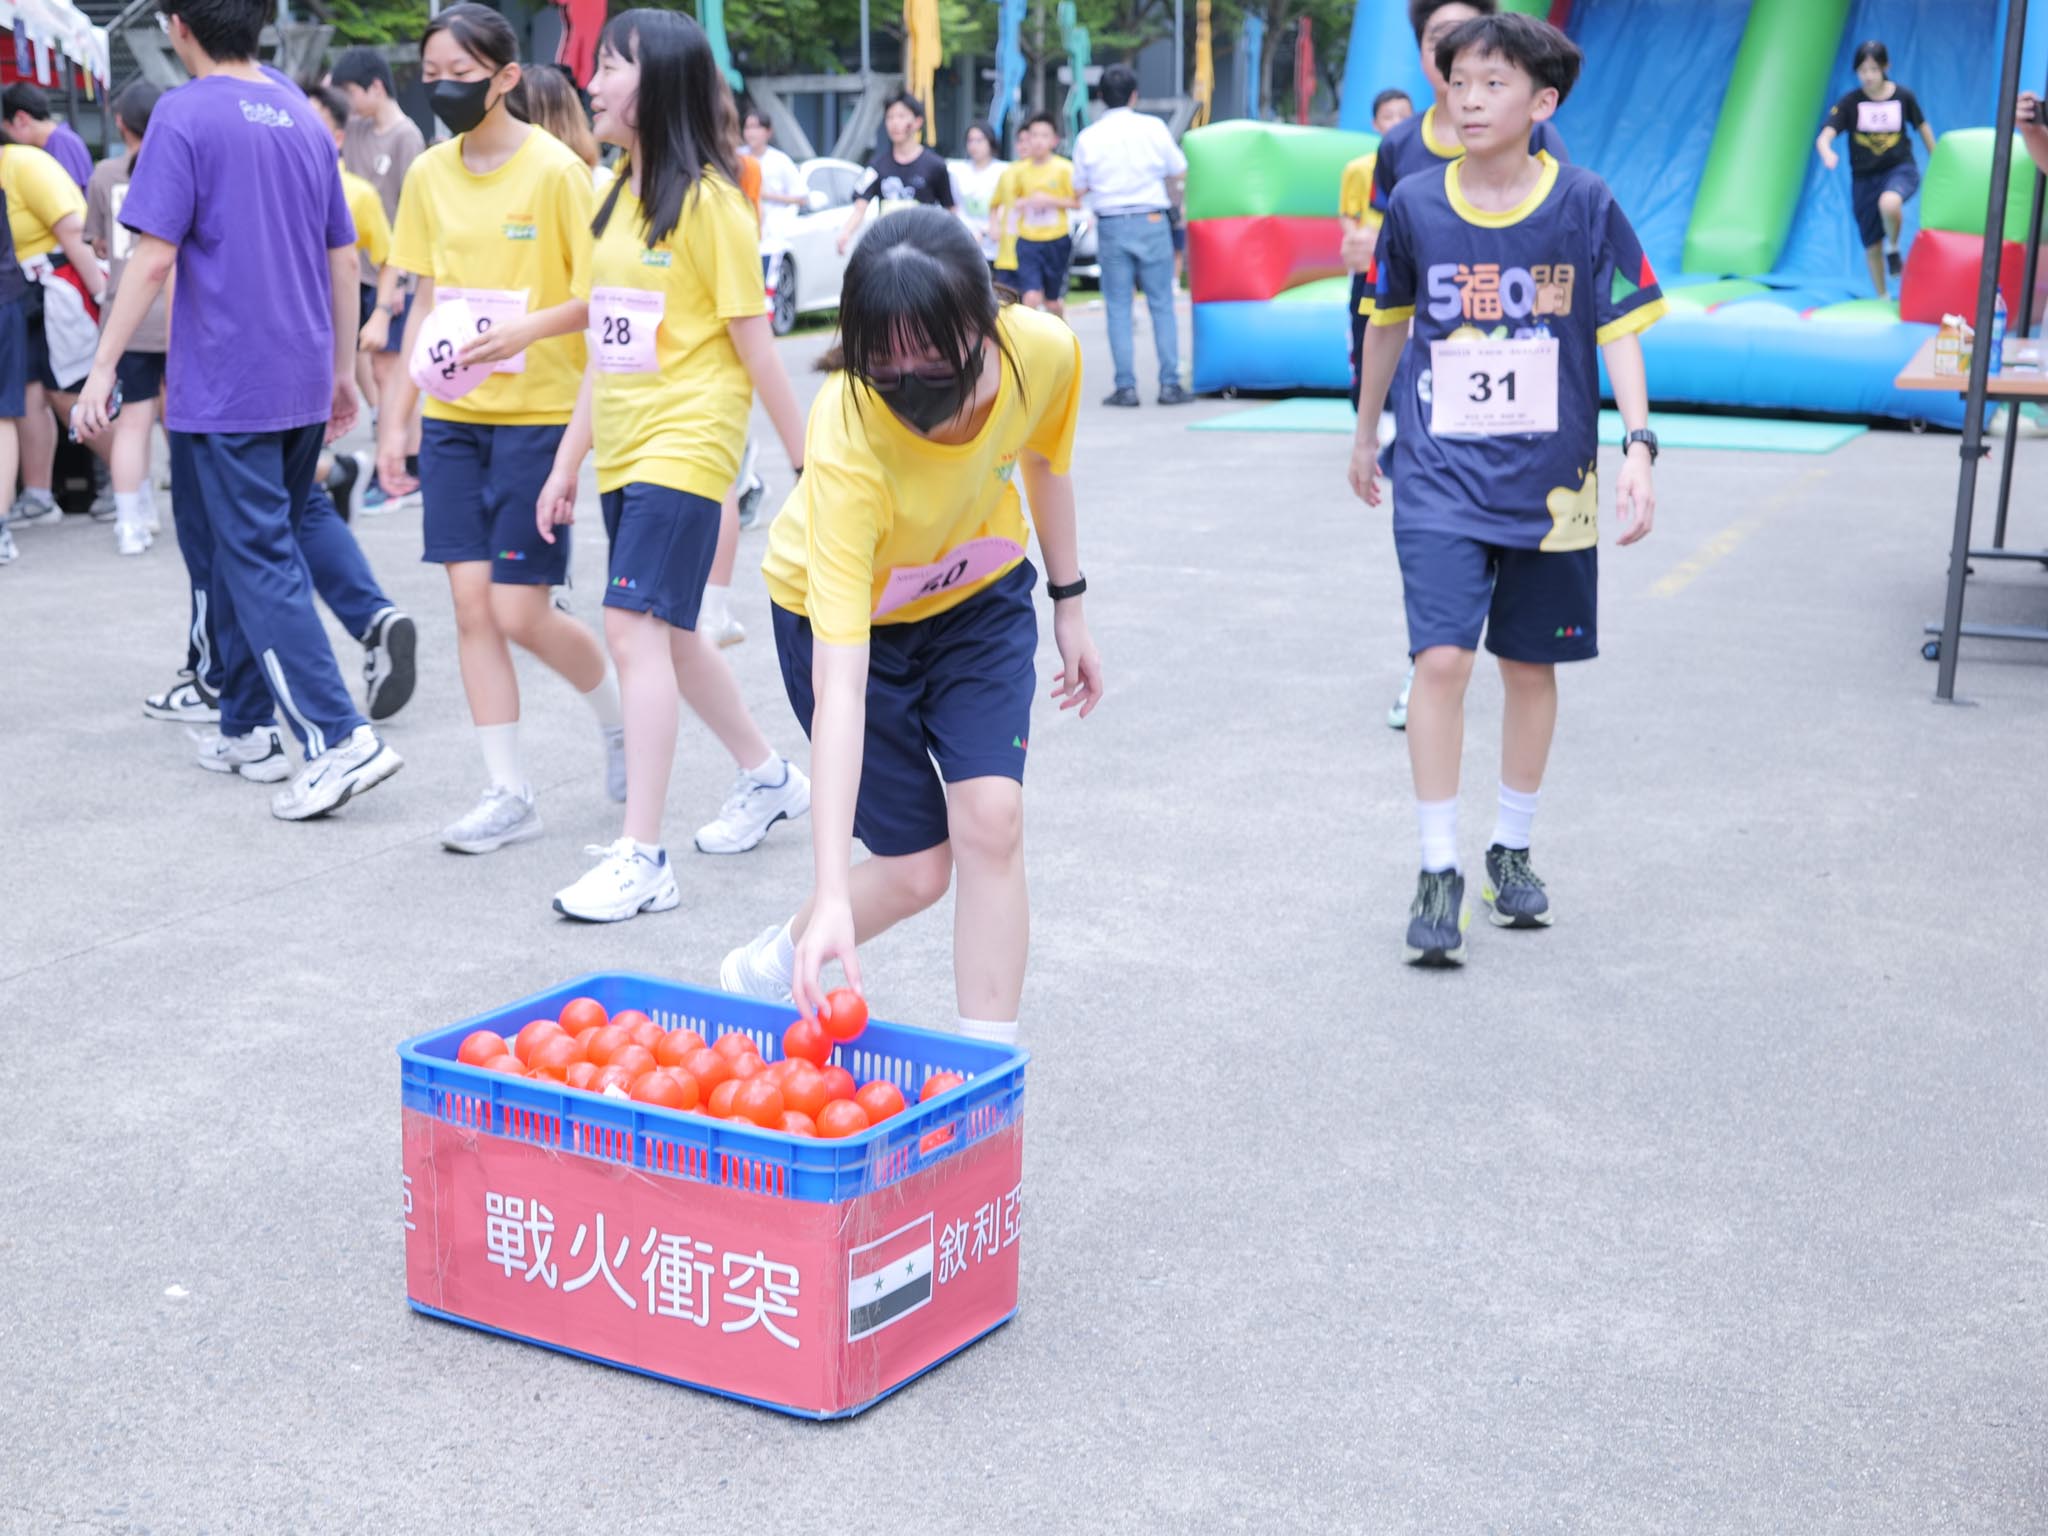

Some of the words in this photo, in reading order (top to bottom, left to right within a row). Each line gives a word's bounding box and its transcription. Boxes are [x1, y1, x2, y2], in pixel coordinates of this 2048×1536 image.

[603, 315, 631, 346] 28
[1468, 370, 1516, 402] 31
[485, 1191, 800, 1349] 戰火衝突
